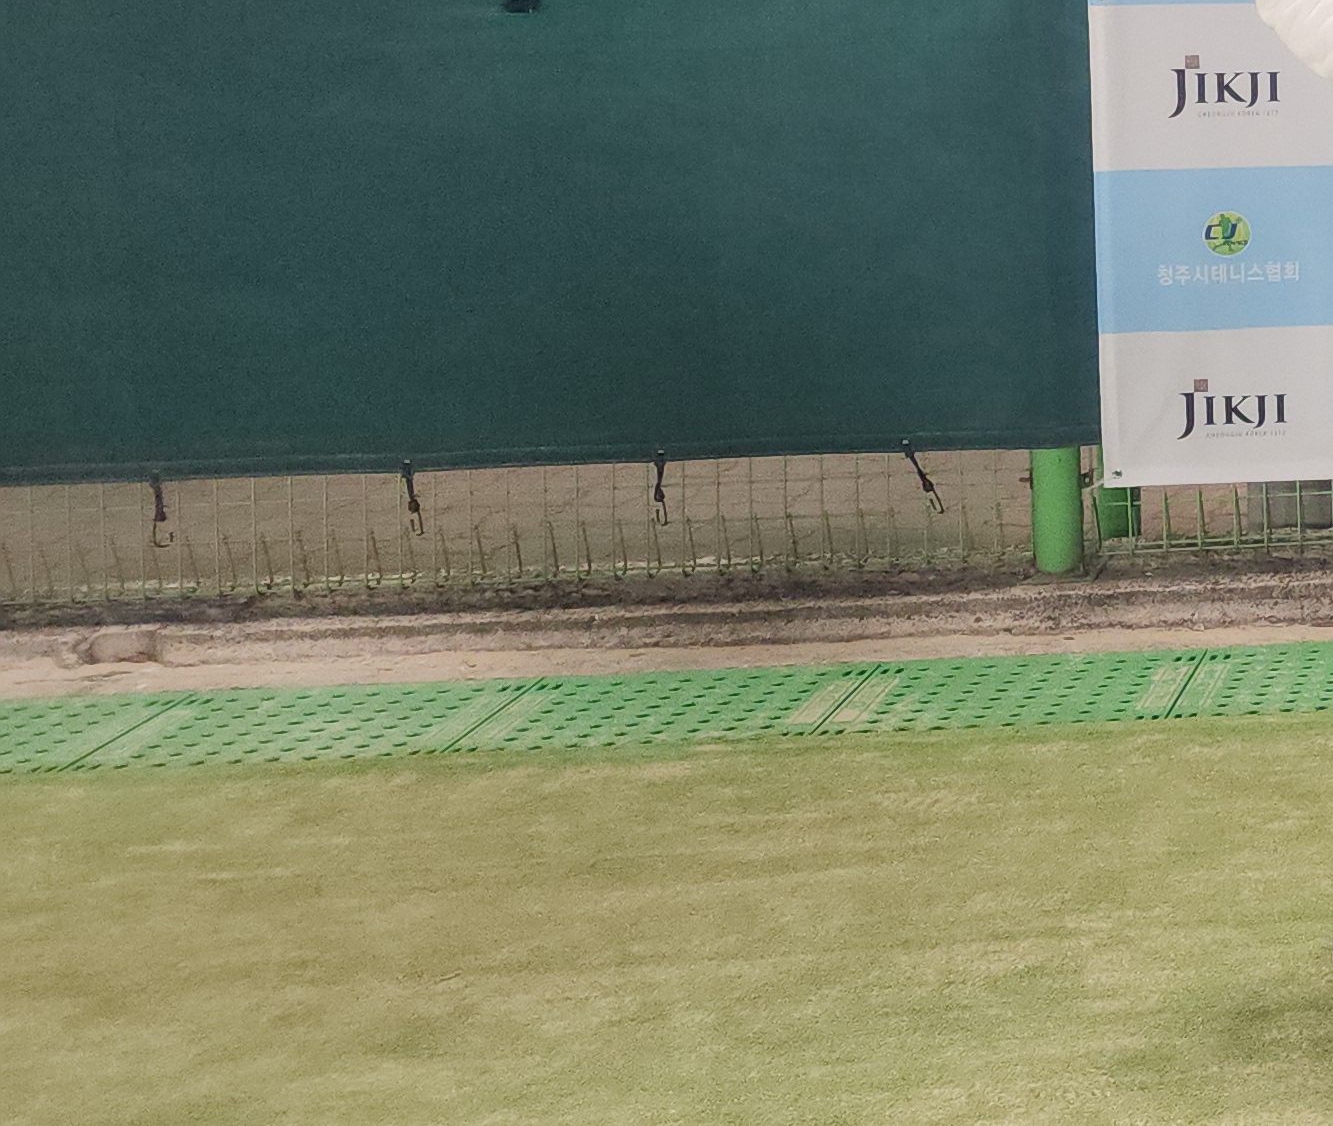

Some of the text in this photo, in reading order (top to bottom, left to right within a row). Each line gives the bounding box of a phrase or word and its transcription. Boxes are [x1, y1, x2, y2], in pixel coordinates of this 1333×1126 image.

[1168, 68, 1280, 119] JIKJI
[1158, 261, 1300, 286] 청주시테니스협회
[1177, 392, 1288, 440] JIKJI
